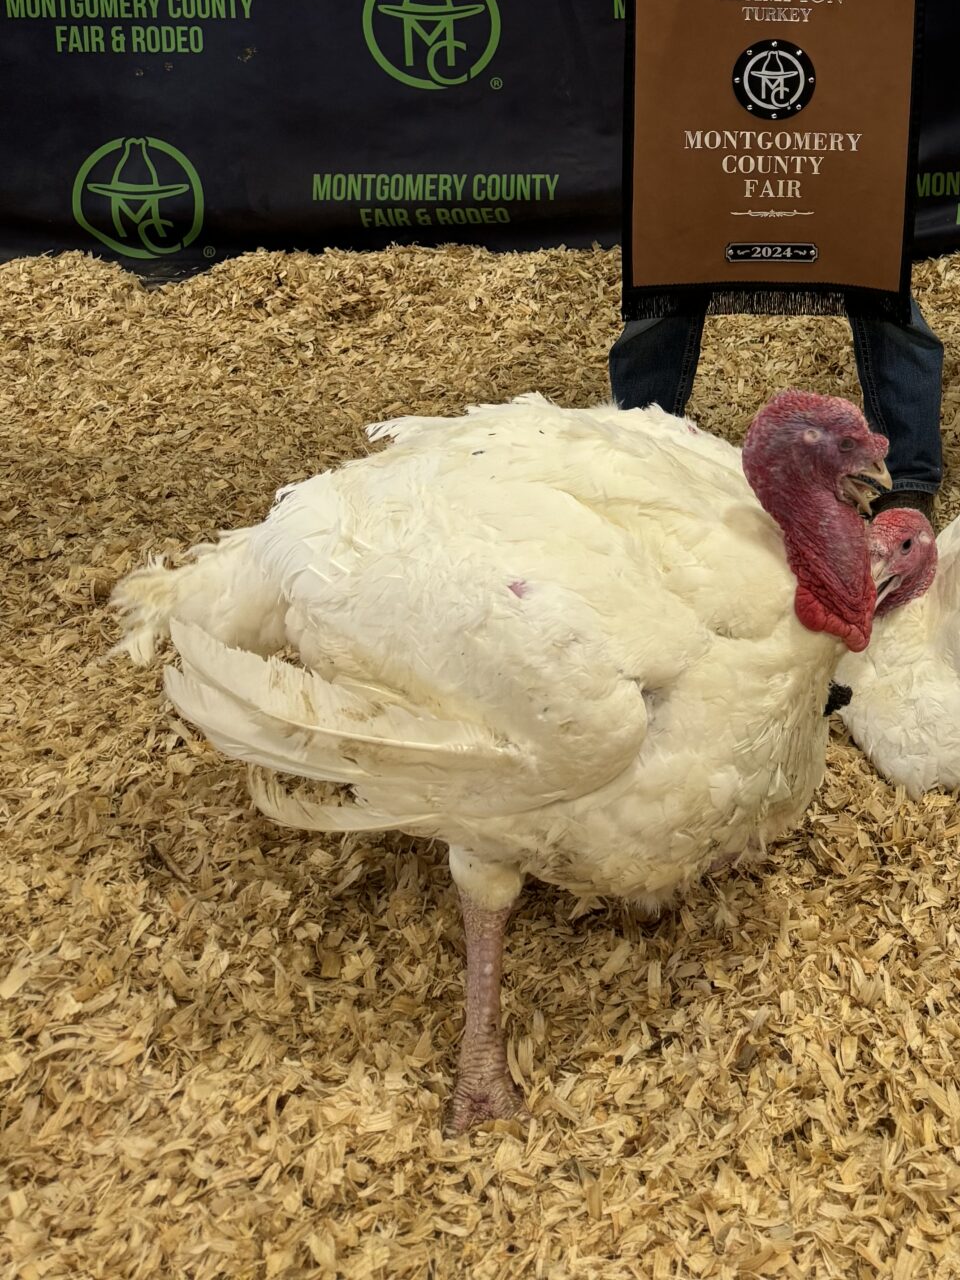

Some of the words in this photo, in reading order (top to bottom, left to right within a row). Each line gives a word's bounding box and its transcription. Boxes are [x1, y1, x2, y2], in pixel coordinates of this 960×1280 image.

[742, 6, 812, 23] TURKEY
[56, 26, 105, 53] FAIR
[111, 26, 126, 53] &
[131, 26, 204, 53] RODEO
[684, 130, 863, 152] MONTGOMERY
[721, 155, 825, 175] COUNTY
[312, 173, 467, 201] MONTGOMERY
[473, 174, 560, 201] COUNTY
[743, 179, 802, 198] FAIR
[360, 208, 409, 227] FAIR
[416, 208, 432, 226] &
[439, 207, 511, 226] RODEO
[751, 246, 793, 259] 2024
